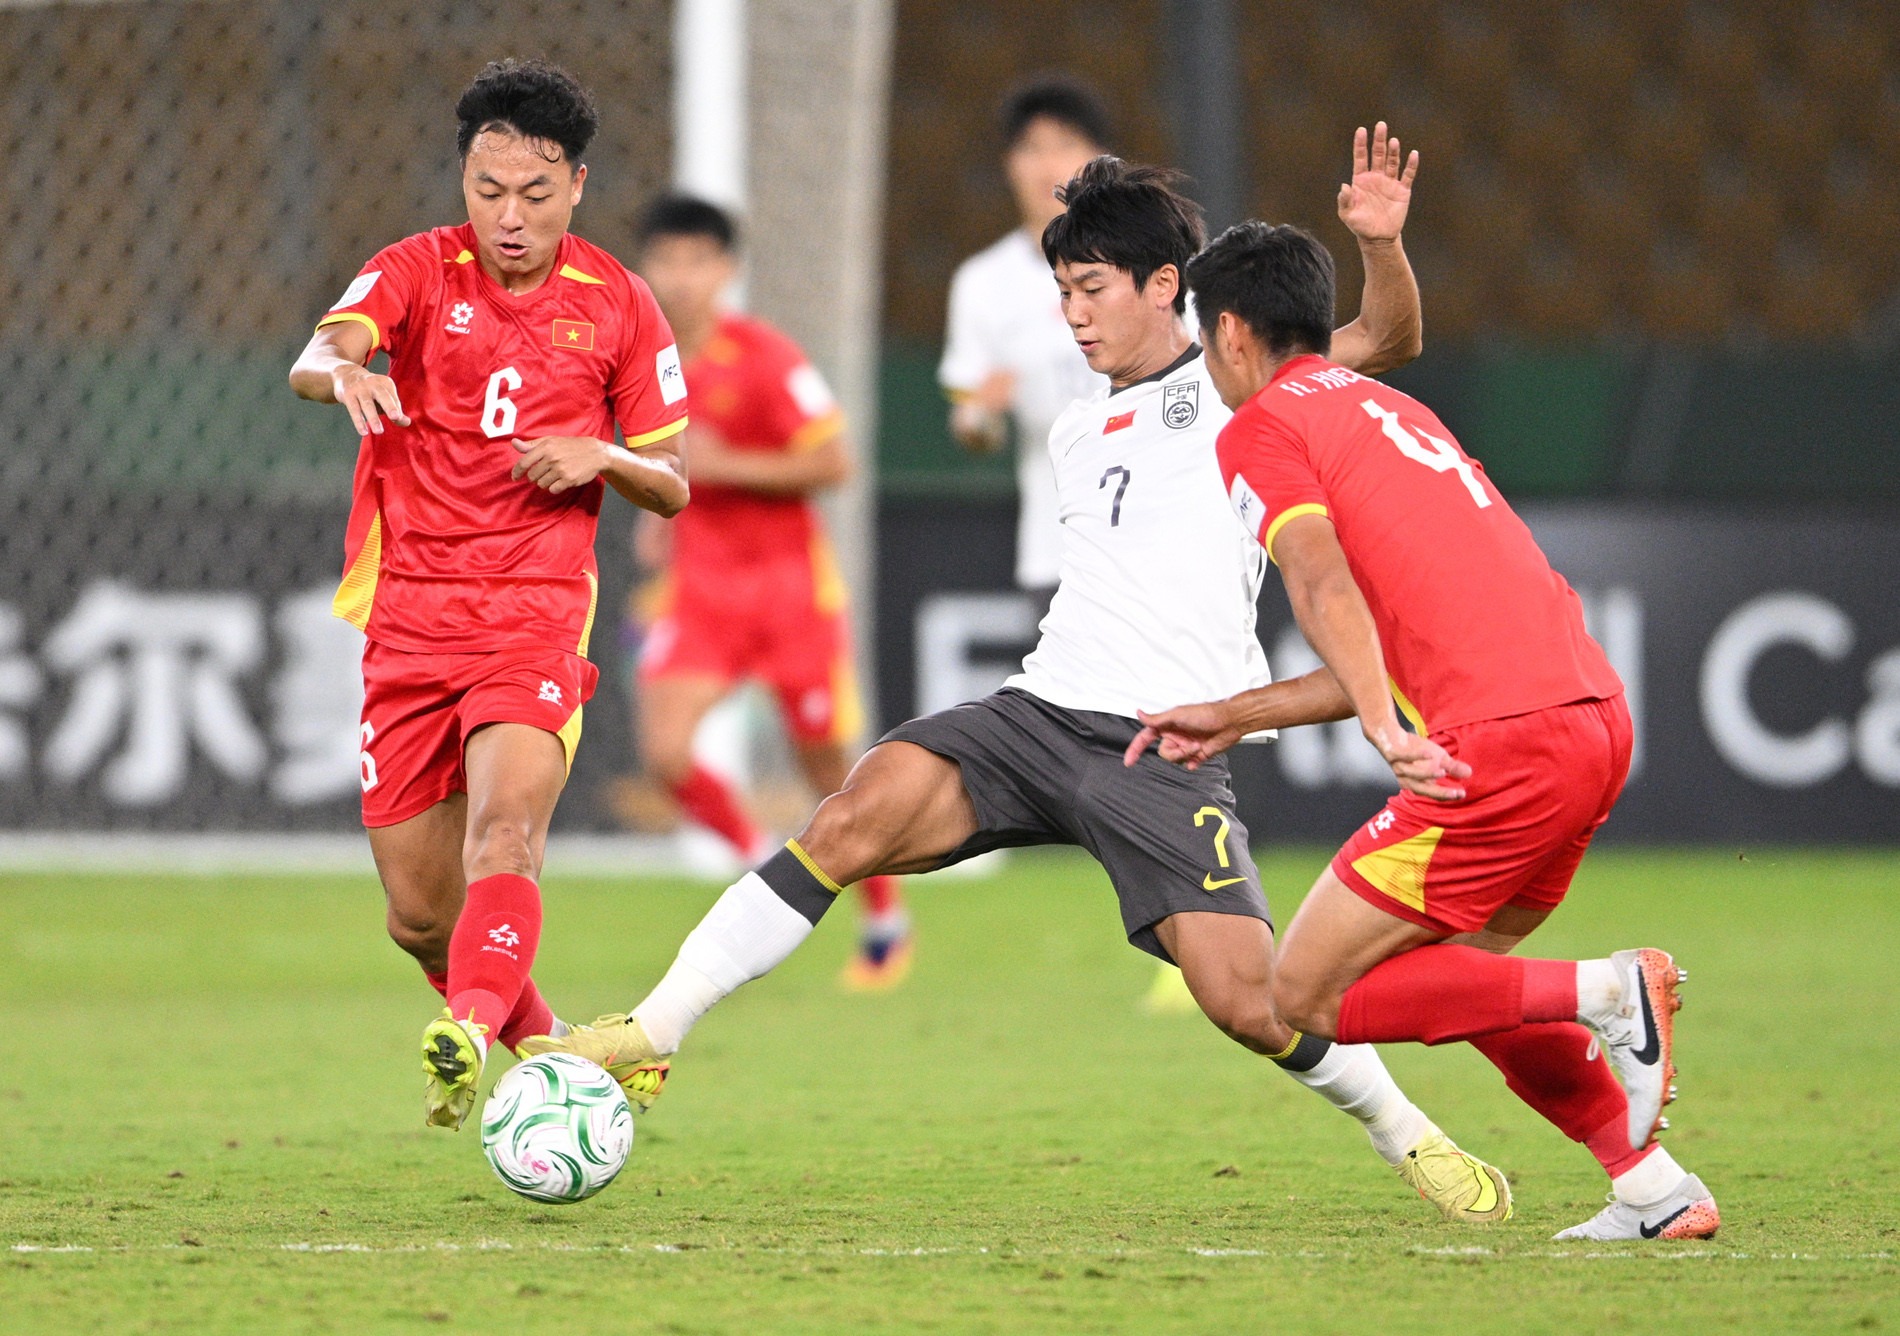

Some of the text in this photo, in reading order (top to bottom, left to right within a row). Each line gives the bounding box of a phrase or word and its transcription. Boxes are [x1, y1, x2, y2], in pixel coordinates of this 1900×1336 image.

[480, 366, 523, 438] 6
[1167, 384, 1196, 397] CFA
[1360, 399, 1492, 508] 4
[1099, 465, 1130, 527] 7
[360, 720, 379, 793] 6
[1193, 806, 1230, 868] 7
